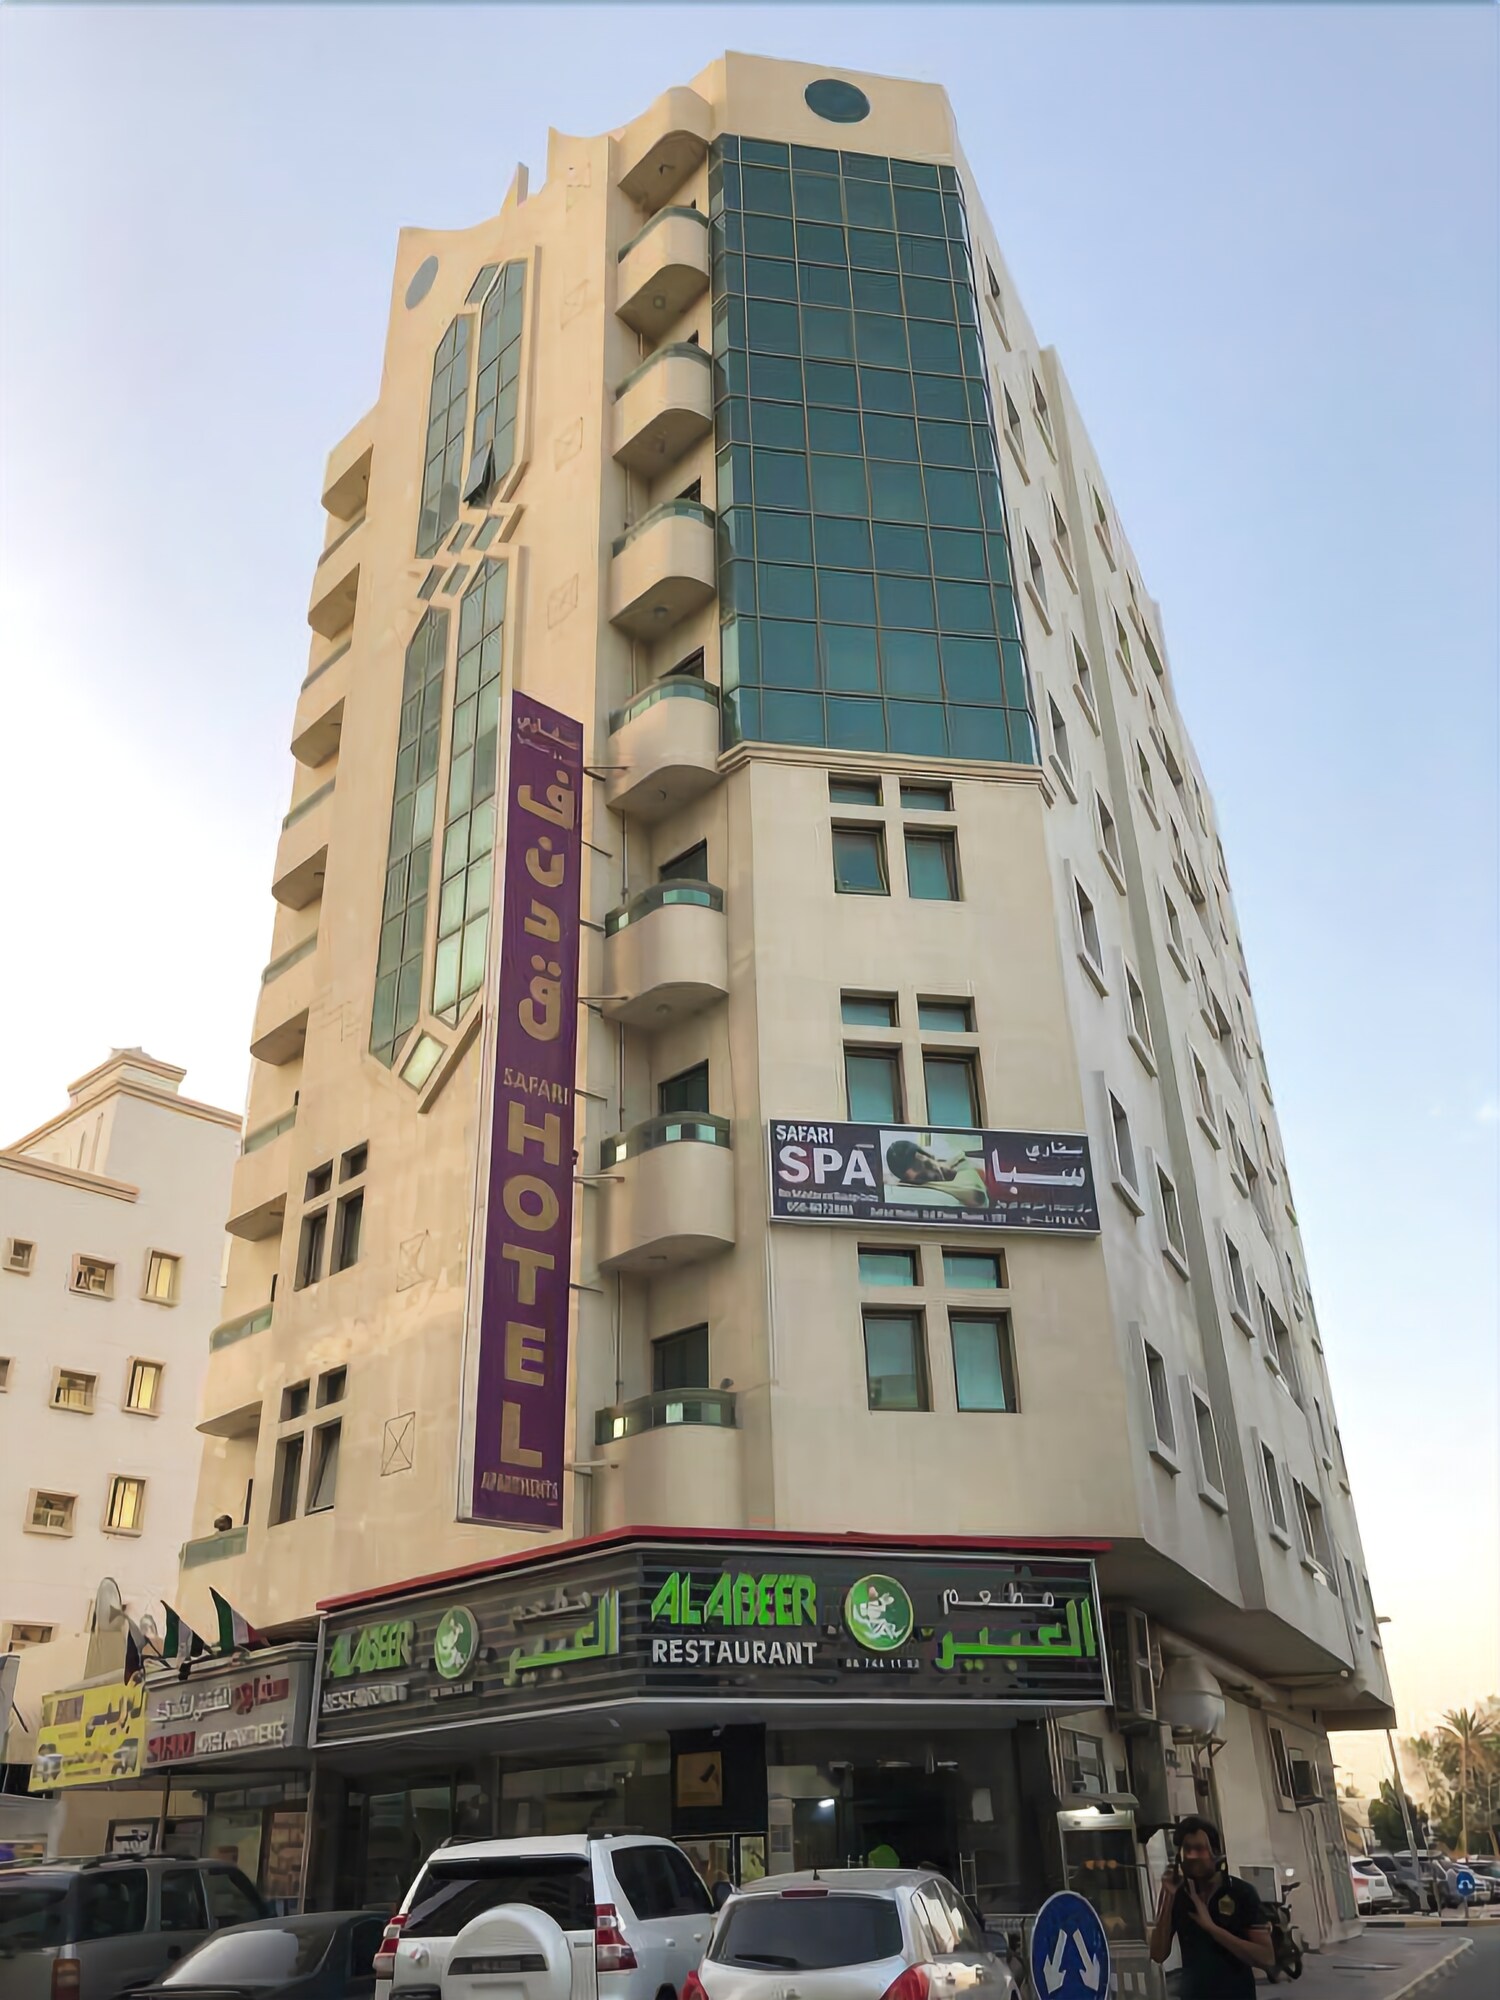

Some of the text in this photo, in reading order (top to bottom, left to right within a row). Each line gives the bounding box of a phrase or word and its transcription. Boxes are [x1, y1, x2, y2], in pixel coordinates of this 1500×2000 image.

[503, 1067, 570, 1106] SAFARI
[776, 1124, 834, 1144] SAFARI
[778, 1145, 877, 1187] SPA
[500, 1100, 561, 1469] HOTEL
[652, 1639, 818, 1665] RESTAURANT
